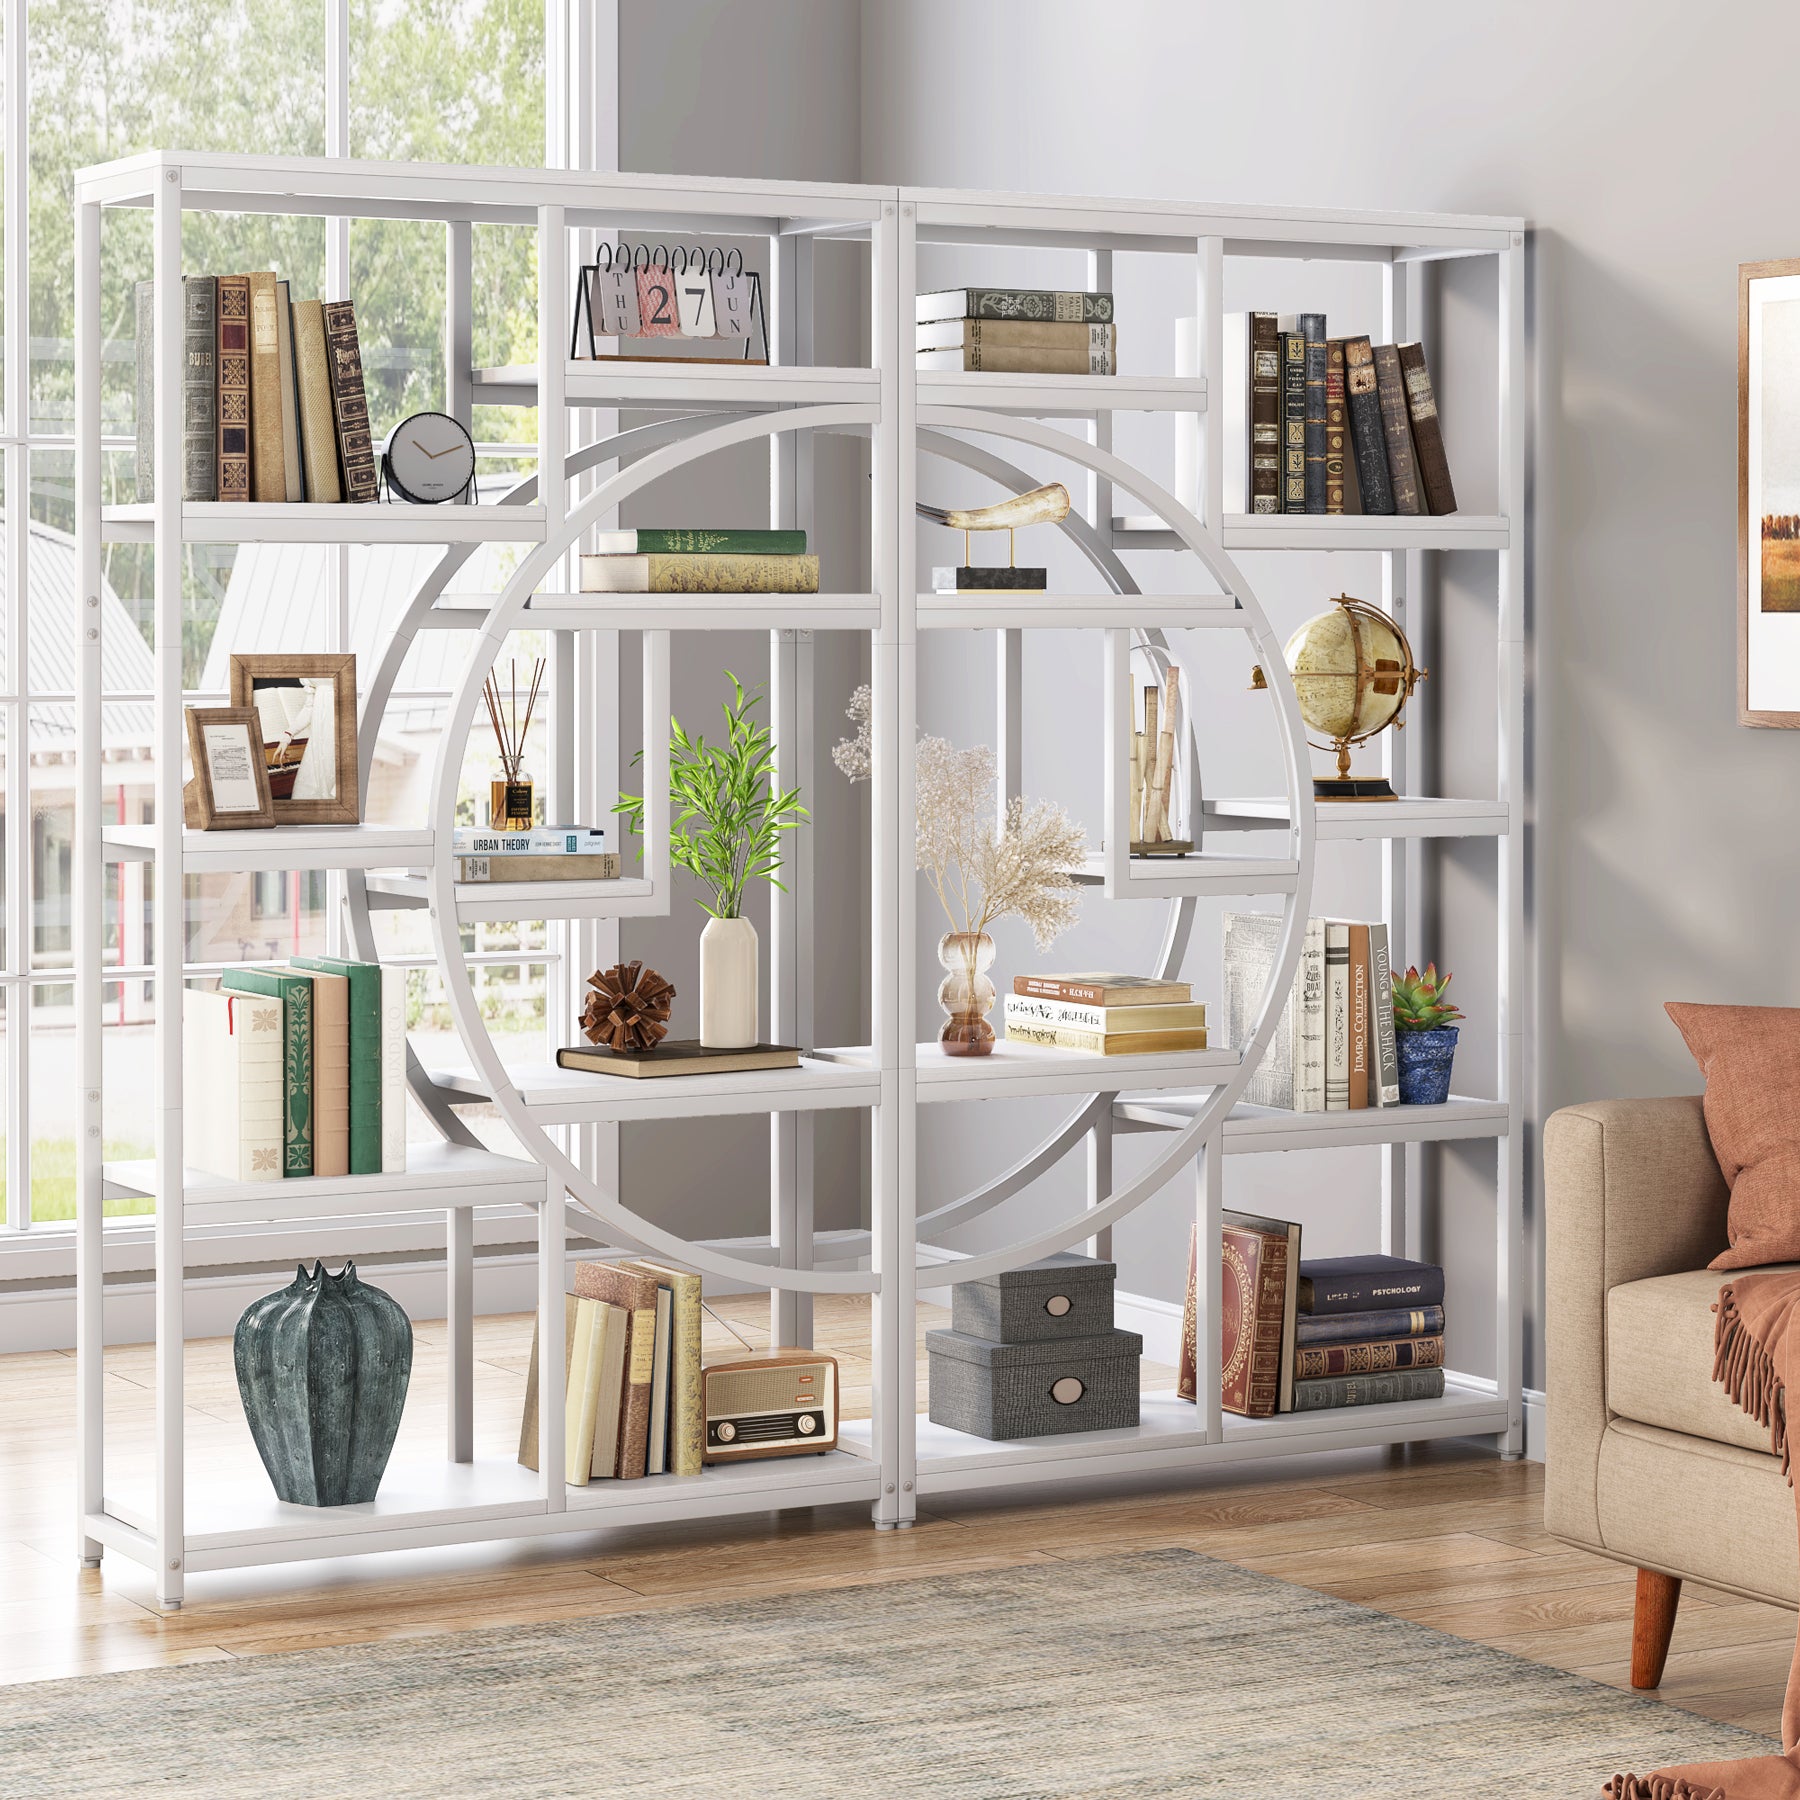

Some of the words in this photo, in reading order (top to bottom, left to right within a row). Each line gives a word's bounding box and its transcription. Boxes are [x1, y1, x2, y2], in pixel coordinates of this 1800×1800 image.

[473, 839, 499, 852] URBAN
[501, 838, 530, 851] THEORY
[1376, 945, 1390, 993] YOUNG
[1353, 964, 1364, 1033] COLLECTION
[1376, 1002, 1393, 1028] THE
[388, 1006, 402, 1088] LUXDECO
[1354, 1034, 1366, 1073] JUMBO
[1380, 1030, 1396, 1073] SHACK
[1372, 1285, 1421, 1296] PSYCHOLOGY
